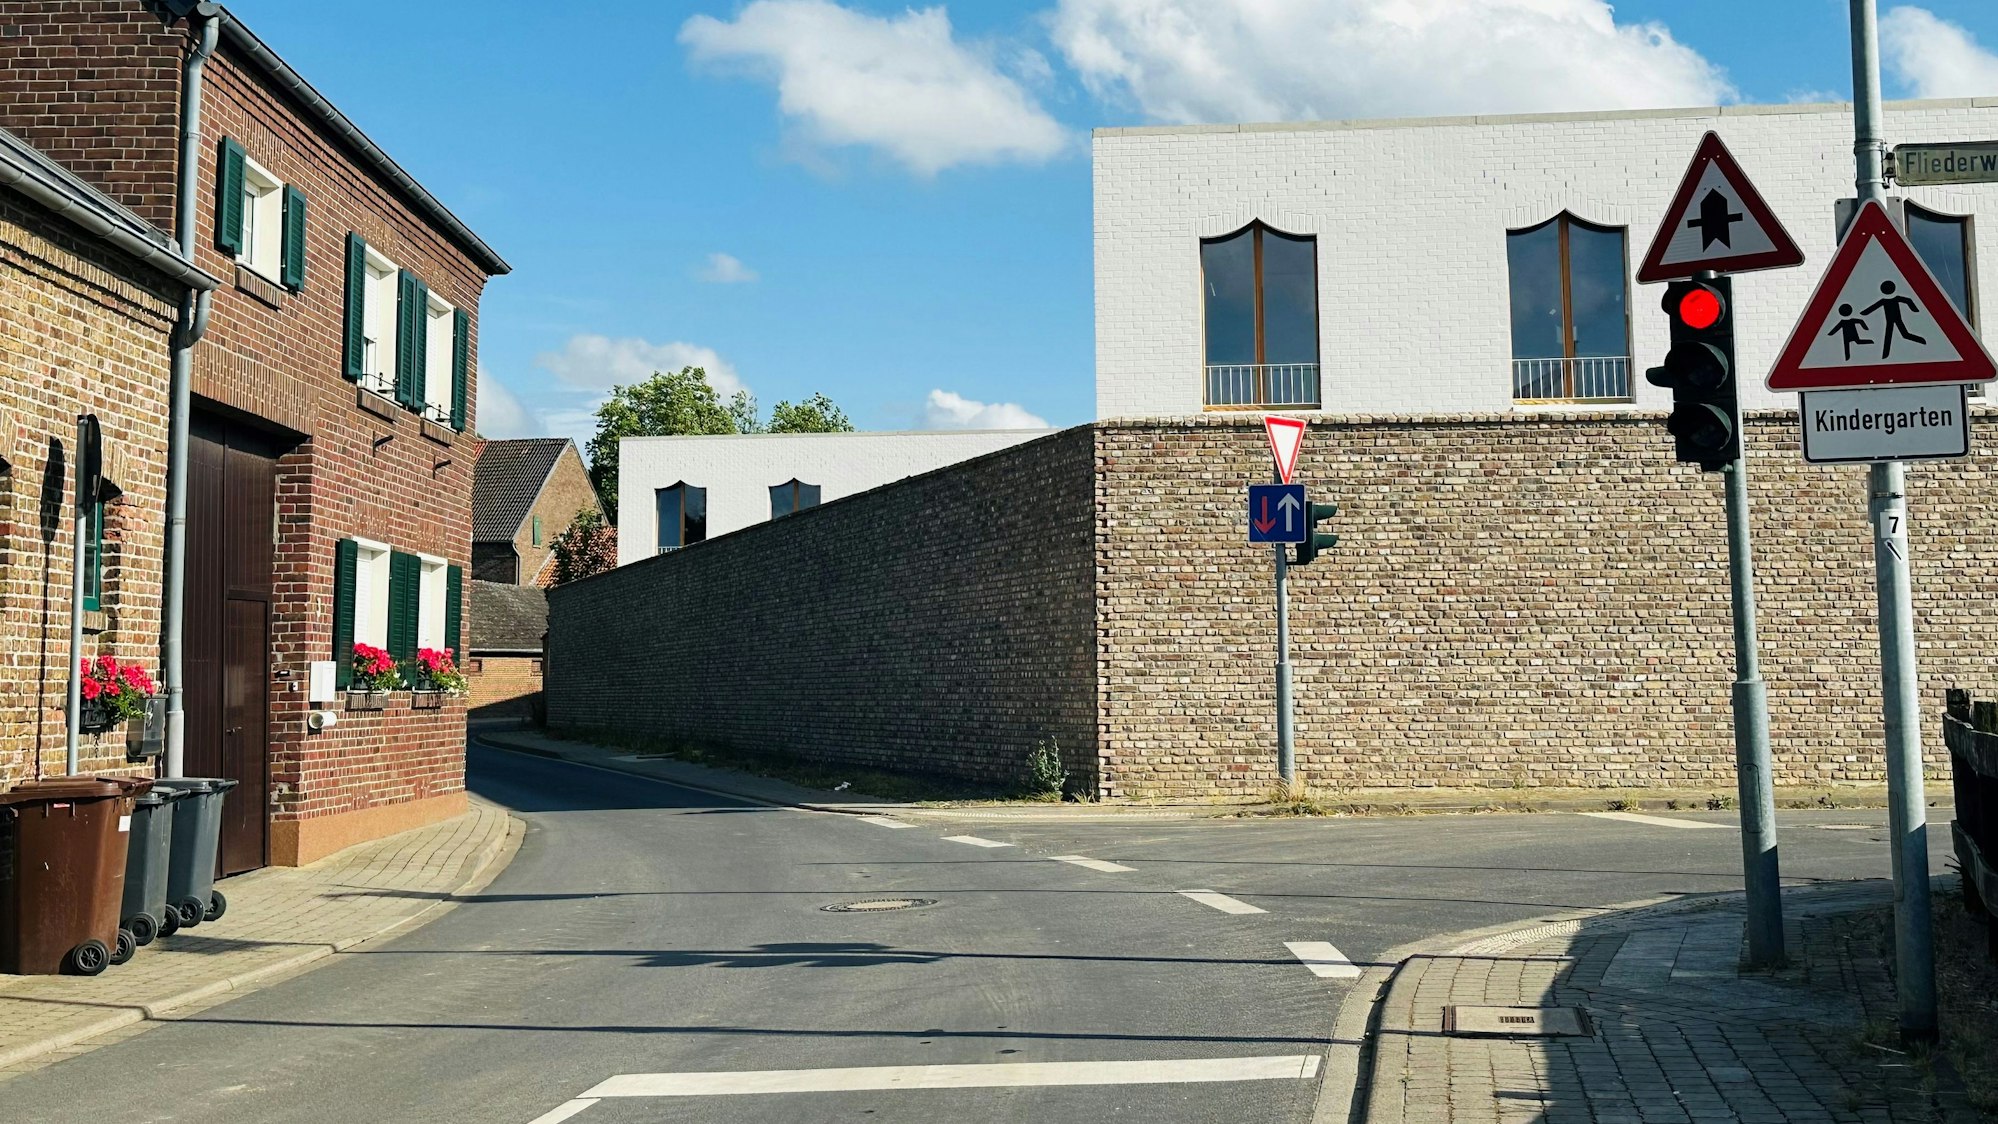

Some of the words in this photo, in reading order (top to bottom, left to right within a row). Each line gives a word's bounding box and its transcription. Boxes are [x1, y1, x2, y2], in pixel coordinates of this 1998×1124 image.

[1905, 150, 1997, 174] Fliederw
[1815, 406, 1952, 434] Kindergarten
[1888, 516, 1899, 534] 7
